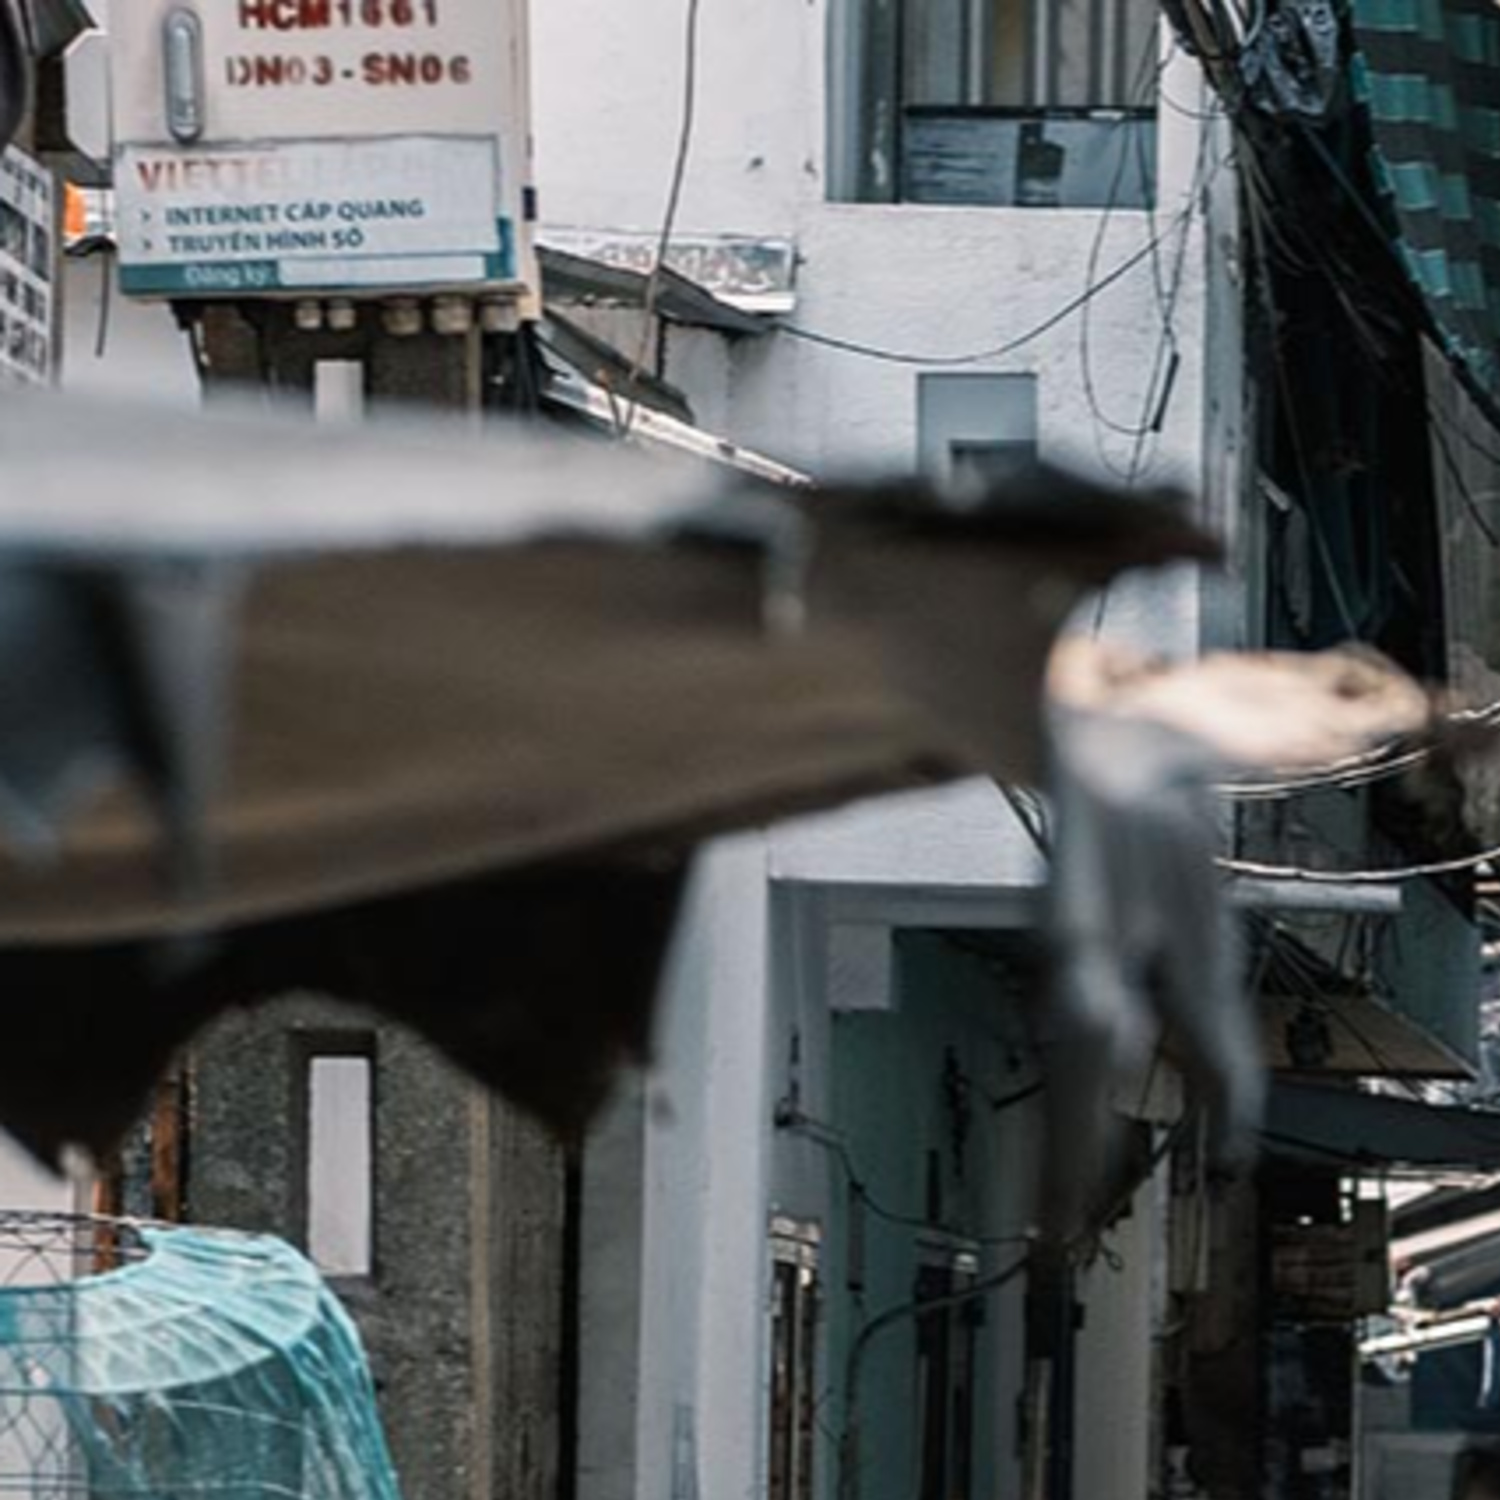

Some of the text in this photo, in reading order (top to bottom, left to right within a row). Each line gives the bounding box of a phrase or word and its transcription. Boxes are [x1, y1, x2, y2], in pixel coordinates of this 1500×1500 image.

[137, 158, 284, 193] VIETTE
[165, 203, 279, 225] INTERNET
[337, 199, 424, 222] QUANG
